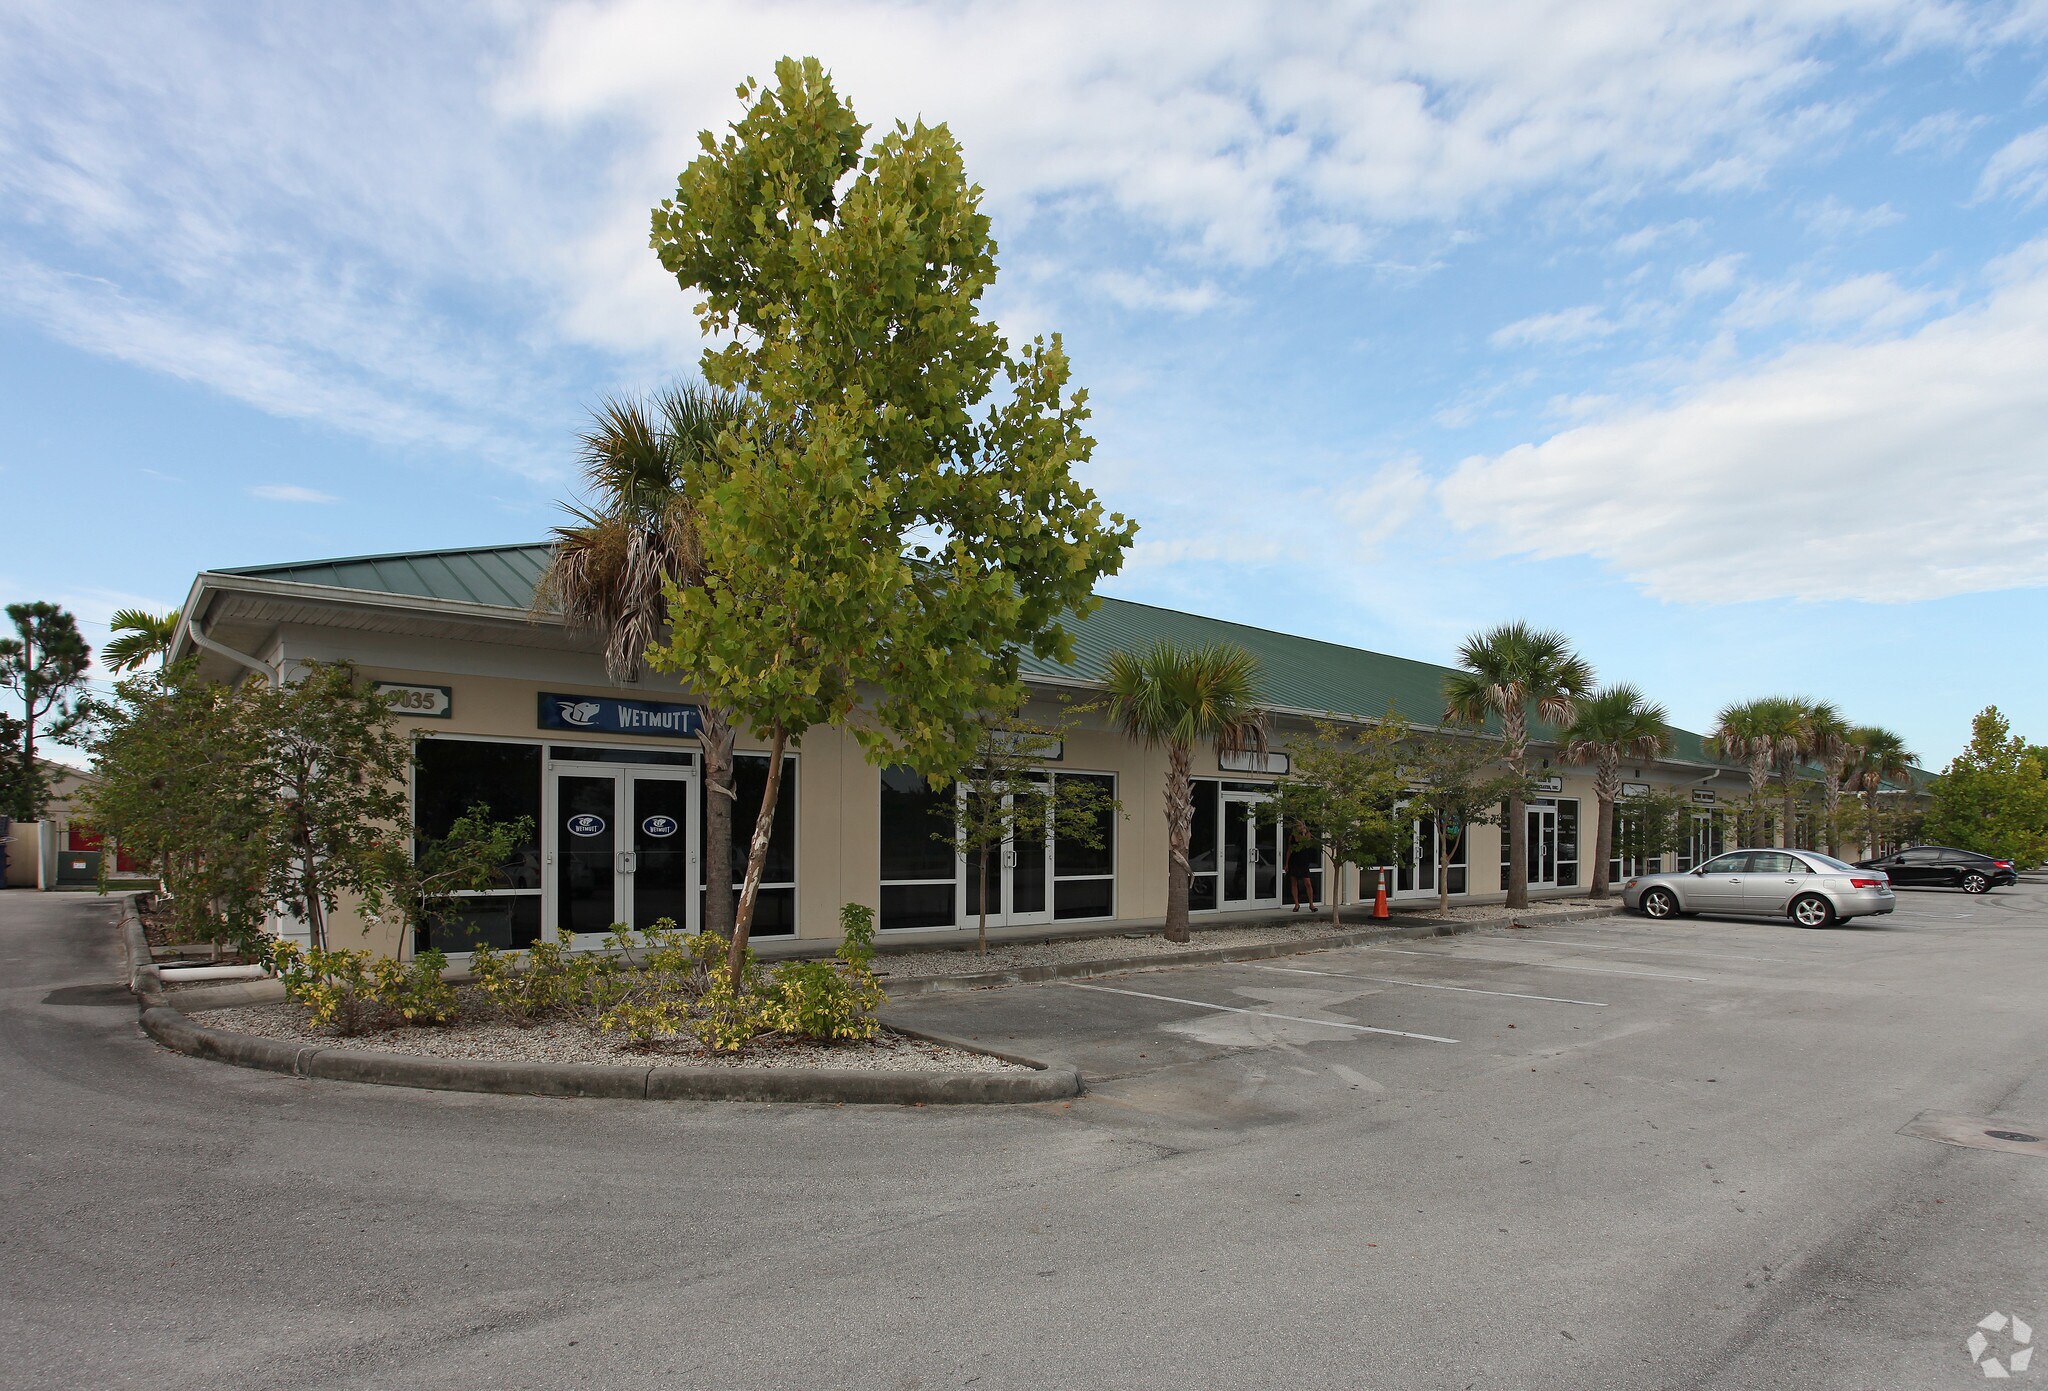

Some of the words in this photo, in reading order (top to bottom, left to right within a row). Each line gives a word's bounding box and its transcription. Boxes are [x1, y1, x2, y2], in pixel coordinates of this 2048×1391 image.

[617, 704, 690, 733] WETMUTT
[575, 825, 598, 833] WETMUTT
[650, 826, 670, 834] WETMUTT
